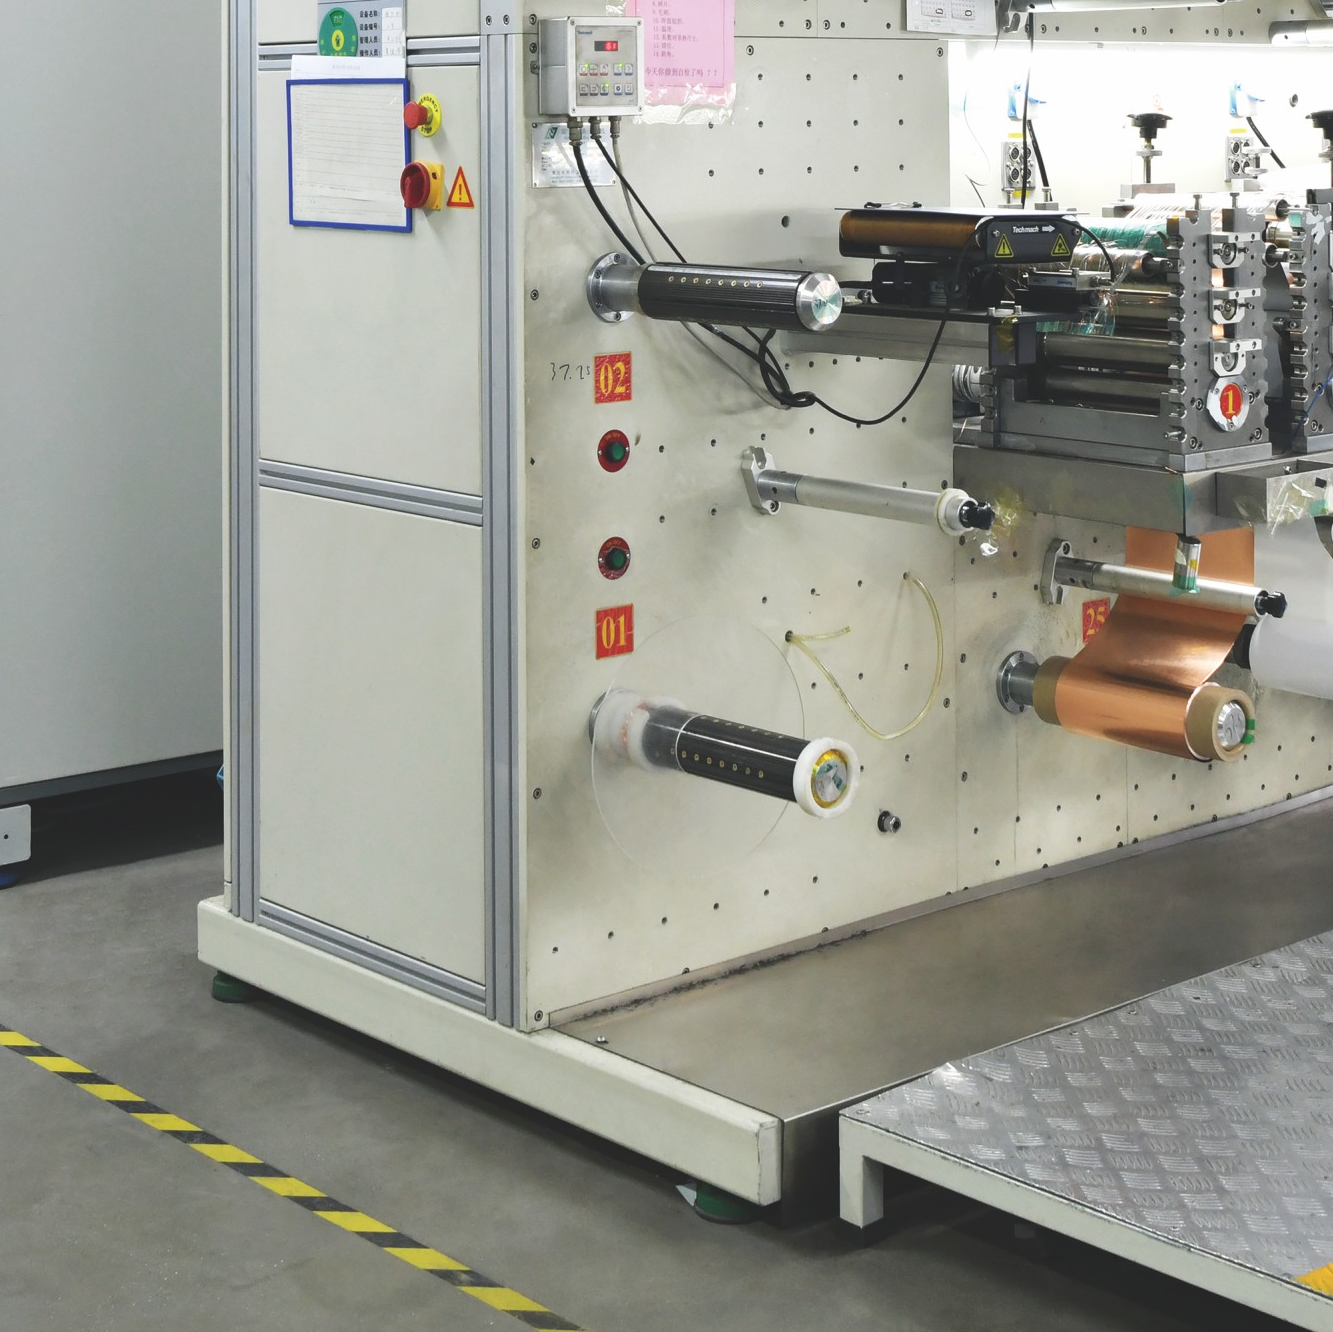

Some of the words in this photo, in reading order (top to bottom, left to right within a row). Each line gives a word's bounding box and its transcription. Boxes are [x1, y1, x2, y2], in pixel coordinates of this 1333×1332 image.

[599, 361, 627, 395] 02
[1225, 390, 1236, 417] 1
[601, 613, 627, 650] 01
